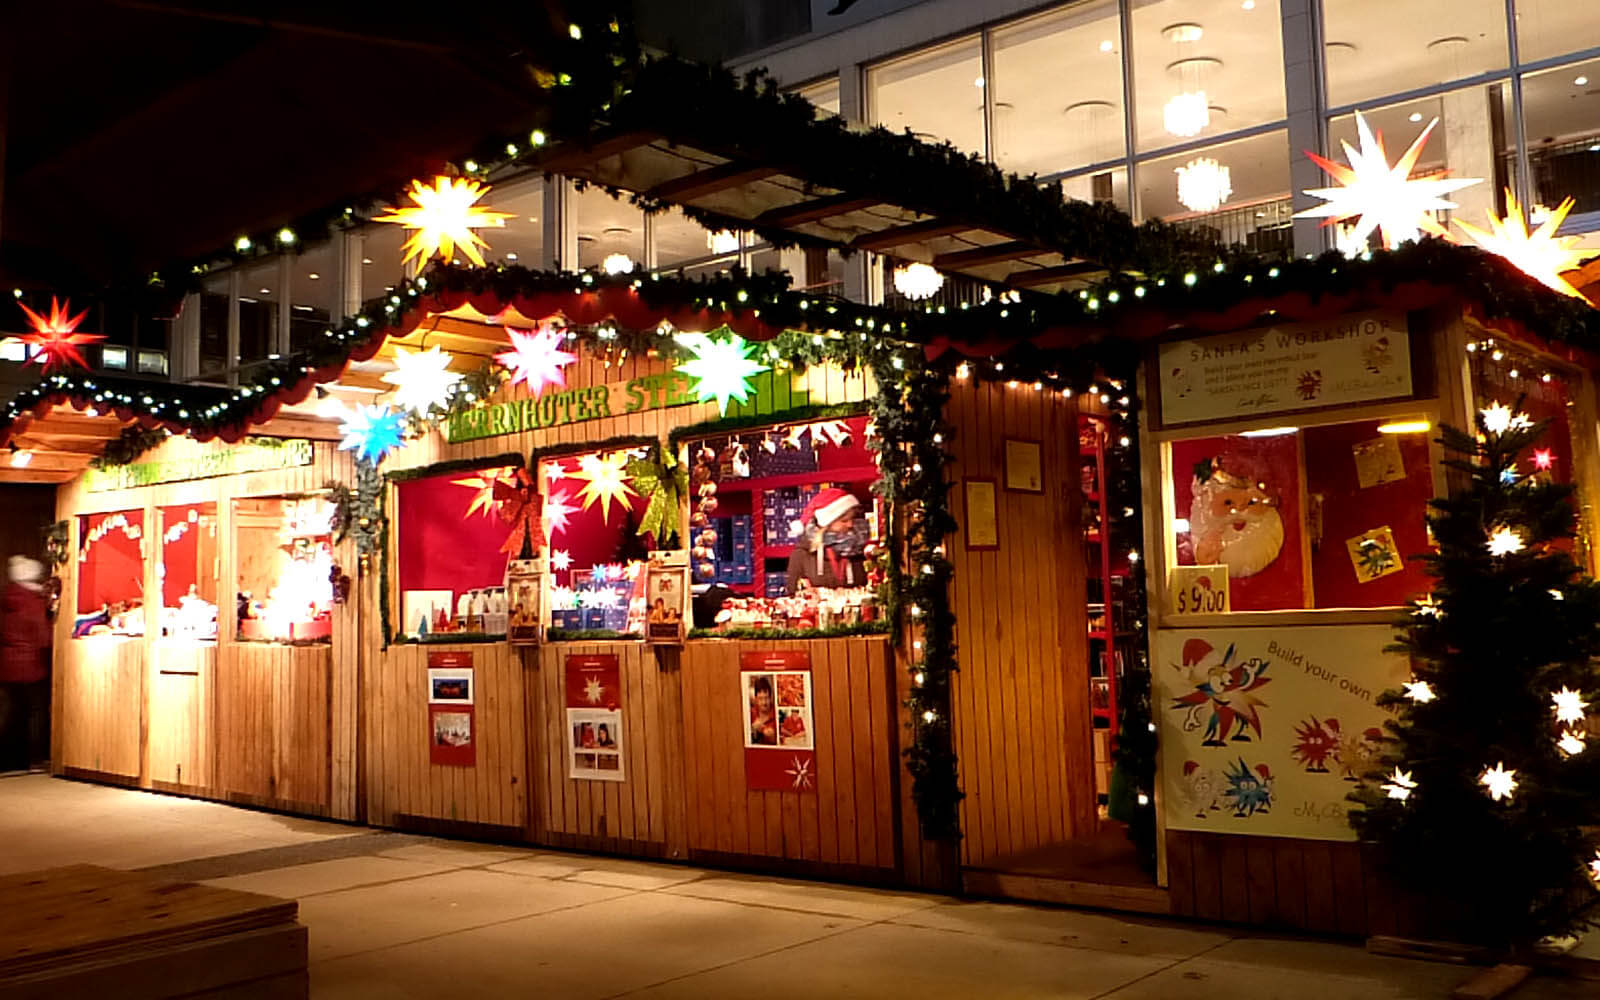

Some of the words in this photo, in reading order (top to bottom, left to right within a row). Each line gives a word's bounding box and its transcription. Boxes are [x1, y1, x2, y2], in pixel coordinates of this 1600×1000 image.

[1276, 319, 1392, 349] WORKSHOP
[449, 384, 611, 442] HERRNHUTER
[1267, 640, 1304, 667] Build
[1304, 661, 1338, 683] your
[1339, 679, 1372, 702] own
